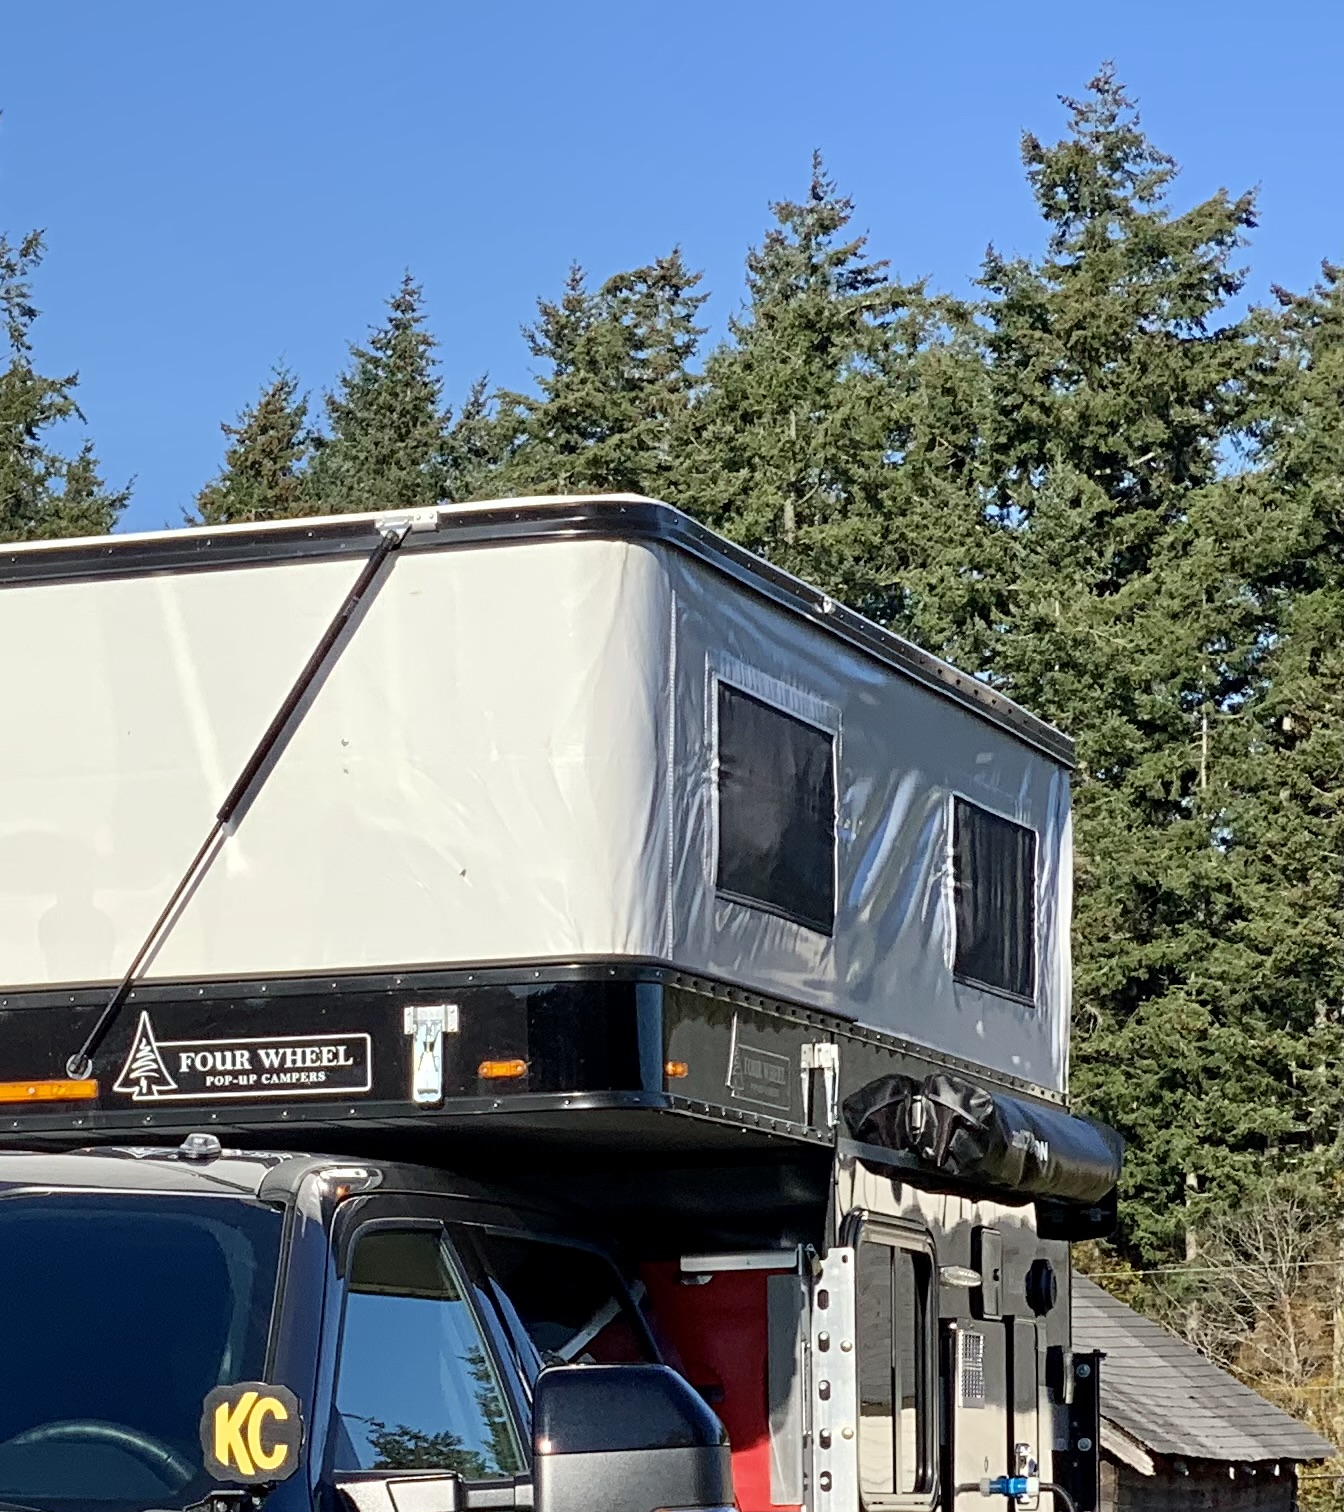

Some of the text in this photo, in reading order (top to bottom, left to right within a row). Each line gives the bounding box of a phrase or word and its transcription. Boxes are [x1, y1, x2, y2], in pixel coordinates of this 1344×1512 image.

[179, 1045, 354, 1073] FOUR WHEEL
[205, 1070, 326, 1087] POP-UP CAMPERS
[215, 1391, 288, 1476] KC
